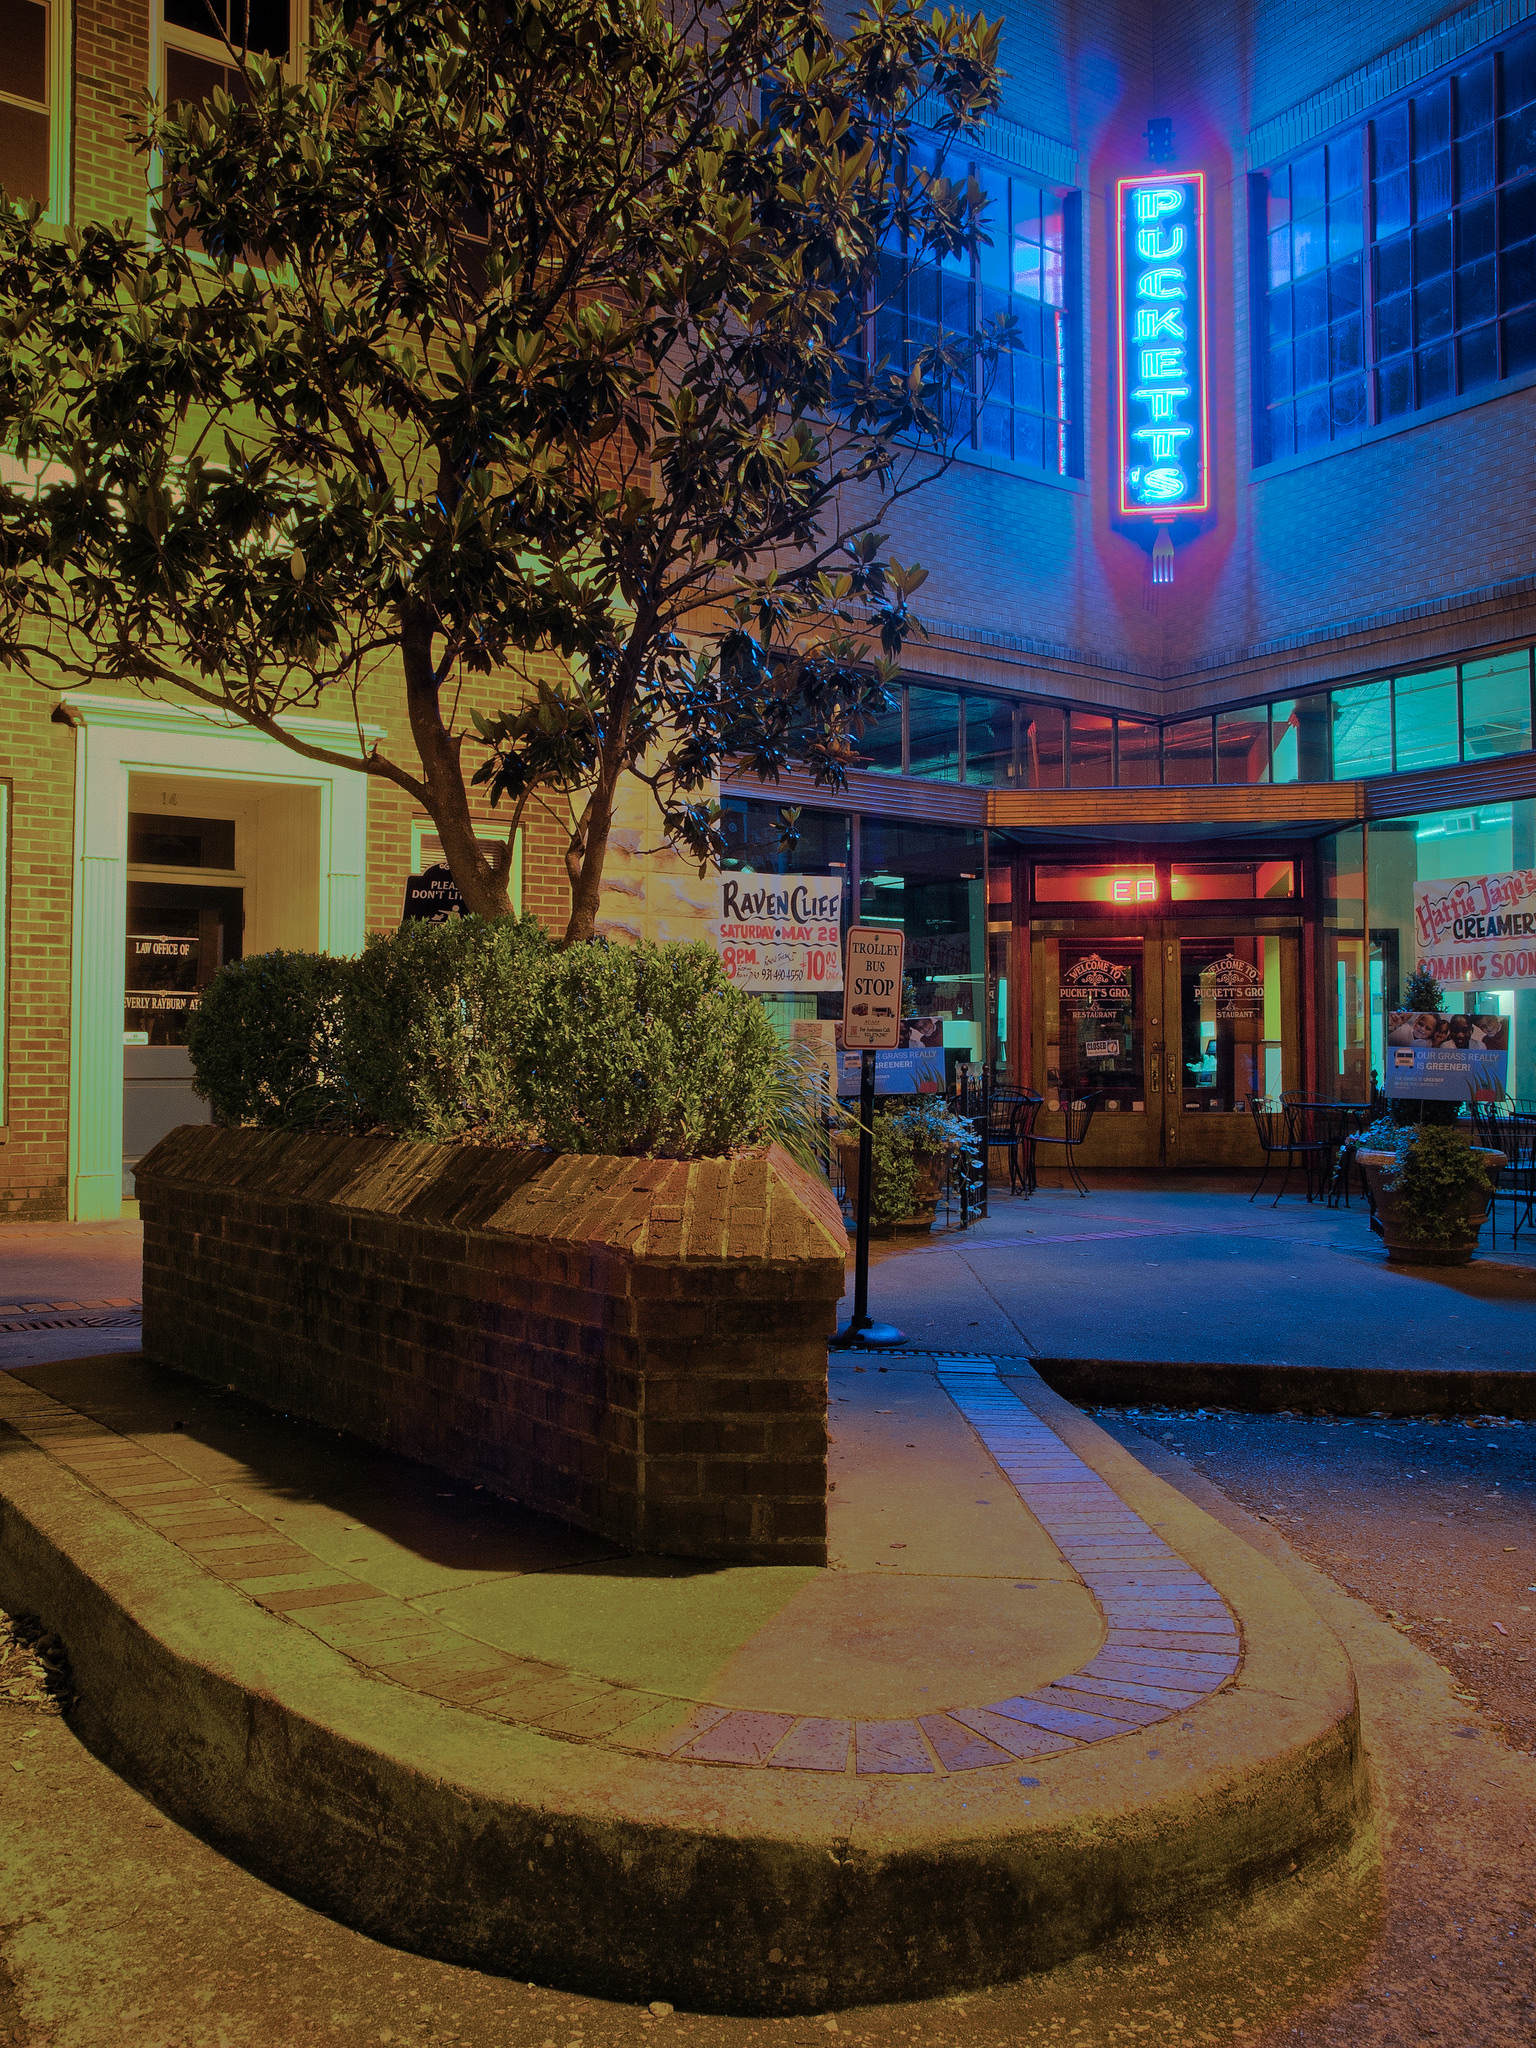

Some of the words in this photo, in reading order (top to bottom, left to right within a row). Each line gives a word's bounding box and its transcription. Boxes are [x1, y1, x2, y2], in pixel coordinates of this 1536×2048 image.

[1132, 188, 1191, 501] PUCKETT'S
[161, 791, 179, 806] 14
[431, 880, 458, 891] PLEA
[1113, 879, 1178, 901] EA
[412, 889, 445, 899] DON'T
[1416, 890, 1475, 946] Hattie
[1477, 870, 1536, 916] Jane's
[720, 924, 776, 939] SATURDAY
[782, 925, 814, 940] MAY
[818, 926, 838, 942] 28
[1453, 912, 1536, 940] CREAMER
[135, 942, 152, 954] LAW
[153, 943, 179, 955] OFFICE
[180, 943, 190, 956] OF
[853, 942, 900, 957] TROLLEY
[866, 960, 885, 972] BUS
[1069, 960, 1109, 979] WELCOME
[1110, 964, 1121, 979] TO
[1245, 963, 1256, 979] TO
[1416, 956, 1487, 981] COMING
[854, 977, 895, 996] STOP
[1060, 987, 1107, 998] PUCKETT'S
[1109, 987, 1130, 998] GRO.
[1194, 987, 1242, 998] PUCKETT'S
[151, 997, 187, 1010] RAYBURN
[1072, 1011, 1117, 1019] RESTAURANT
[1087, 1041, 1107, 1051] CLOSED
[882, 1051, 908, 1060] GRASS
[909, 1050, 937, 1058] REALLY
[1417, 1051, 1436, 1060] OUR
[1438, 1052, 1466, 1061] GRASS
[1468, 1052, 1499, 1063] REALLY
[1417, 1062, 1424, 1070] IS
[1426, 1062, 1471, 1072] GREENER!
